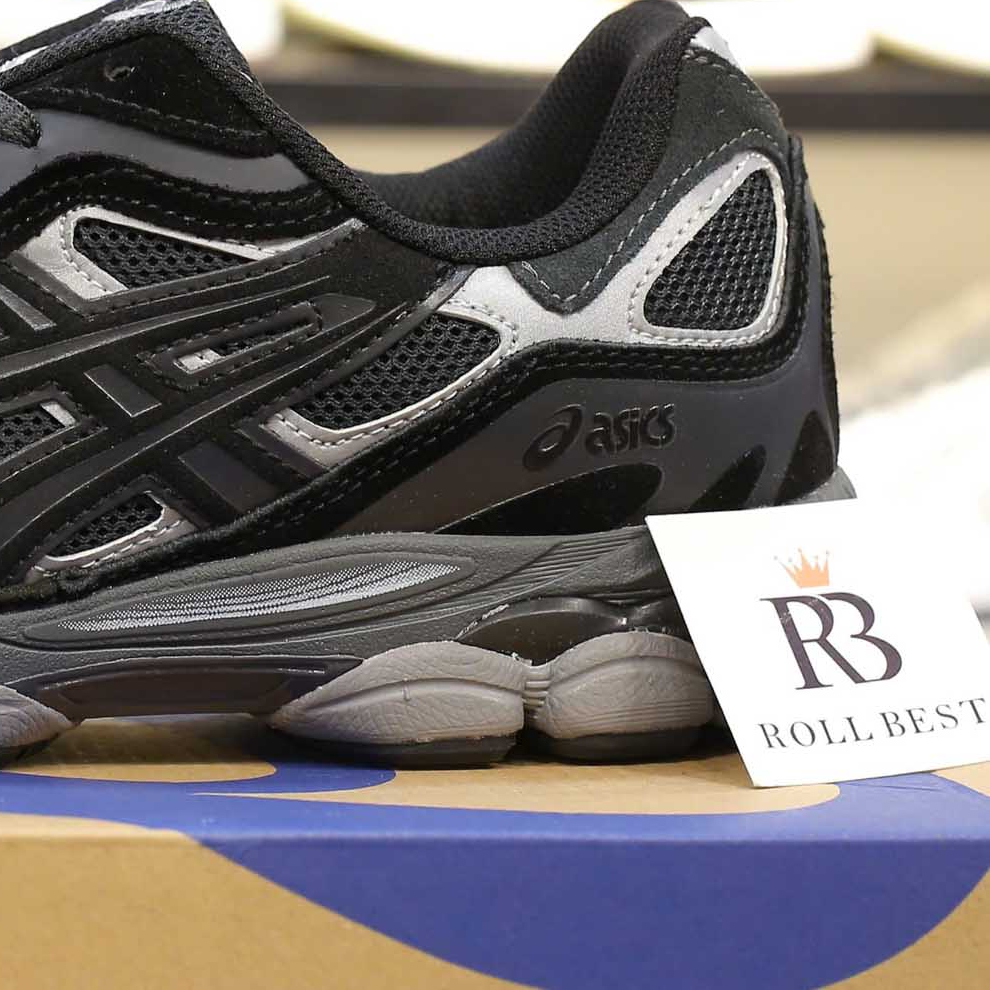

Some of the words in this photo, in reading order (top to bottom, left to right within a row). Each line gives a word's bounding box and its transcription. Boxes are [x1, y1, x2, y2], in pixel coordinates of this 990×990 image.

[585, 403, 676, 455] asics
[760, 592, 902, 690] RB
[757, 716, 873, 749] ROLL
[879, 697, 987, 738] BEST
